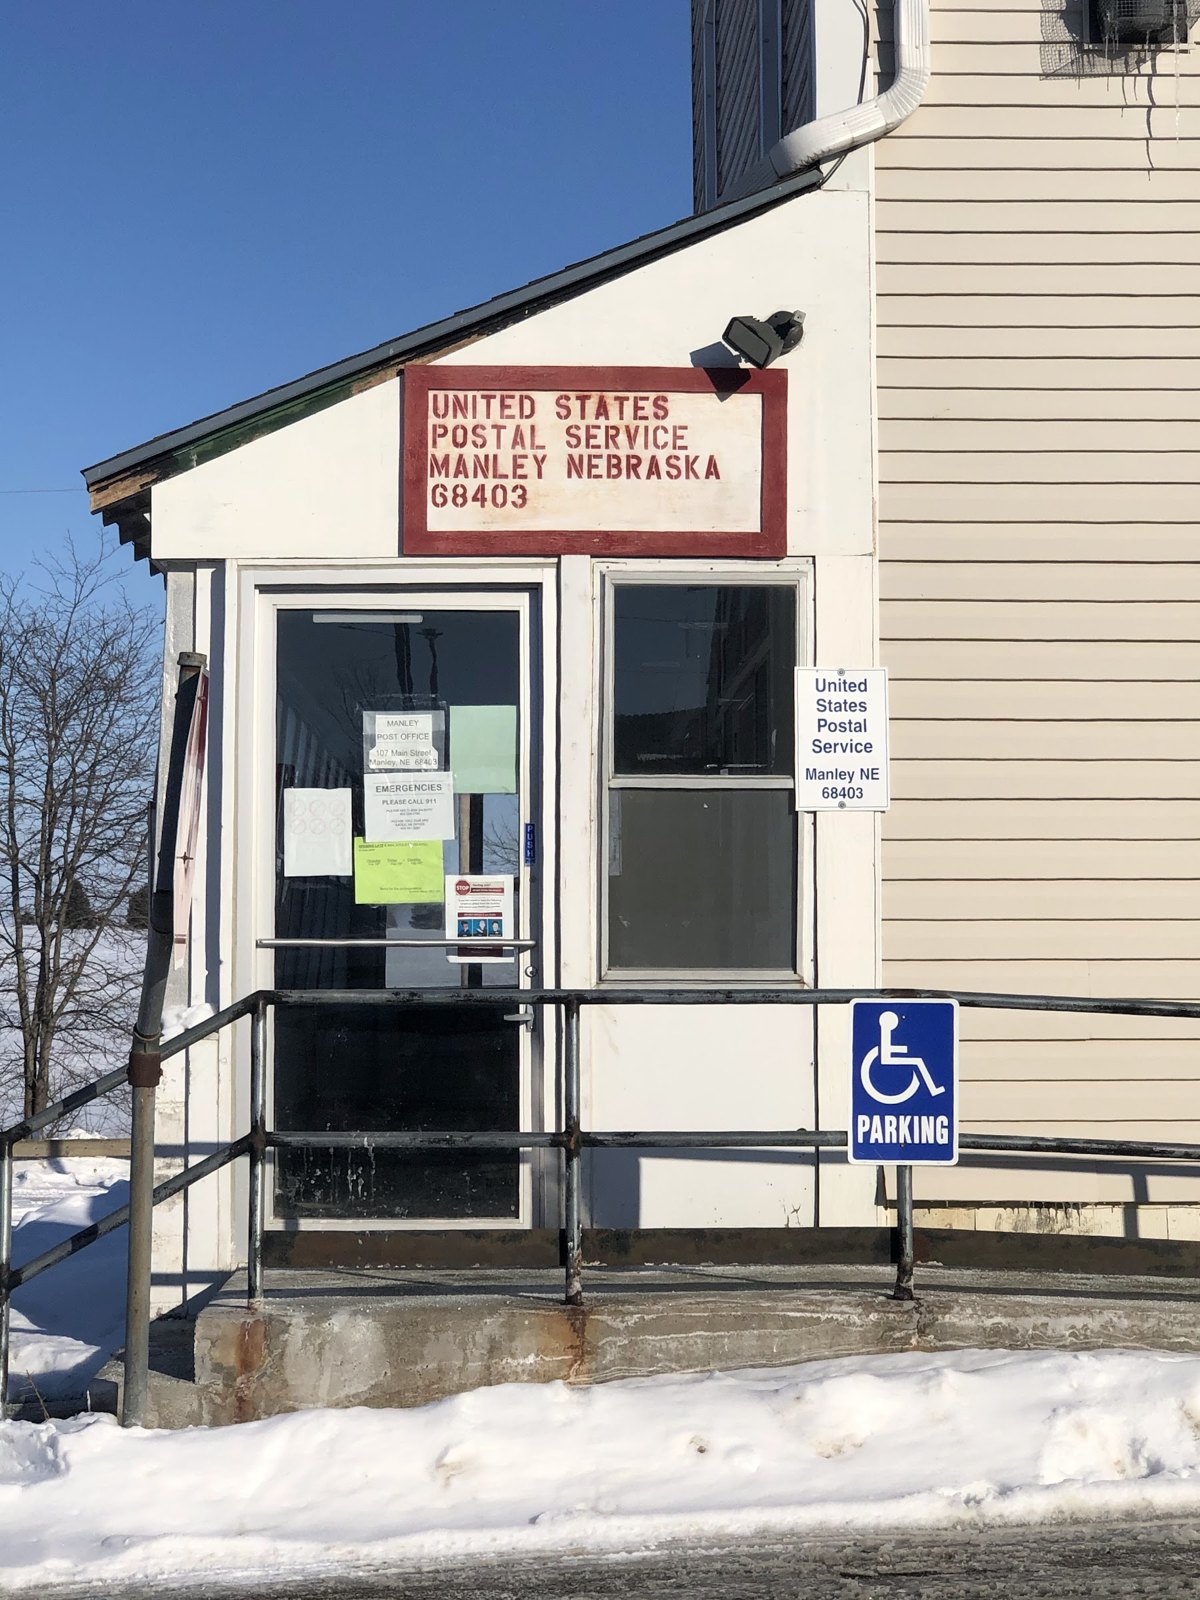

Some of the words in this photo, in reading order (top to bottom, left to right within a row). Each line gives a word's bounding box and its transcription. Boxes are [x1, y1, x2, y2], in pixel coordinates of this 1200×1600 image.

[432, 393, 536, 420] UNITED
[555, 394, 670, 421] STATES
[431, 424, 547, 450] POSTAL
[565, 425, 689, 451] SERVICE
[429, 453, 547, 480] MANLEY
[566, 454, 721, 480] NEBRASKA
[430, 483, 529, 509] 68403
[815, 678, 868, 693] United
[816, 698, 868, 713] States
[386, 719, 419, 727] MANLEY
[817, 718, 867, 733] Postal
[376, 733, 399, 741] POST
[400, 732, 430, 741] OFFICE
[376, 749, 389, 757] 107
[391, 749, 408, 757] Main
[409, 749, 432, 757] Street
[811, 738, 873, 754] Service
[399, 758, 411, 766] NE
[805, 767, 855, 784] Manley
[860, 767, 880, 780] NE
[375, 783, 443, 793] EMERGENCIES
[821, 786, 864, 799] 68403
[456, 884, 470, 892] STOP
[857, 1114, 949, 1145] PARKING
